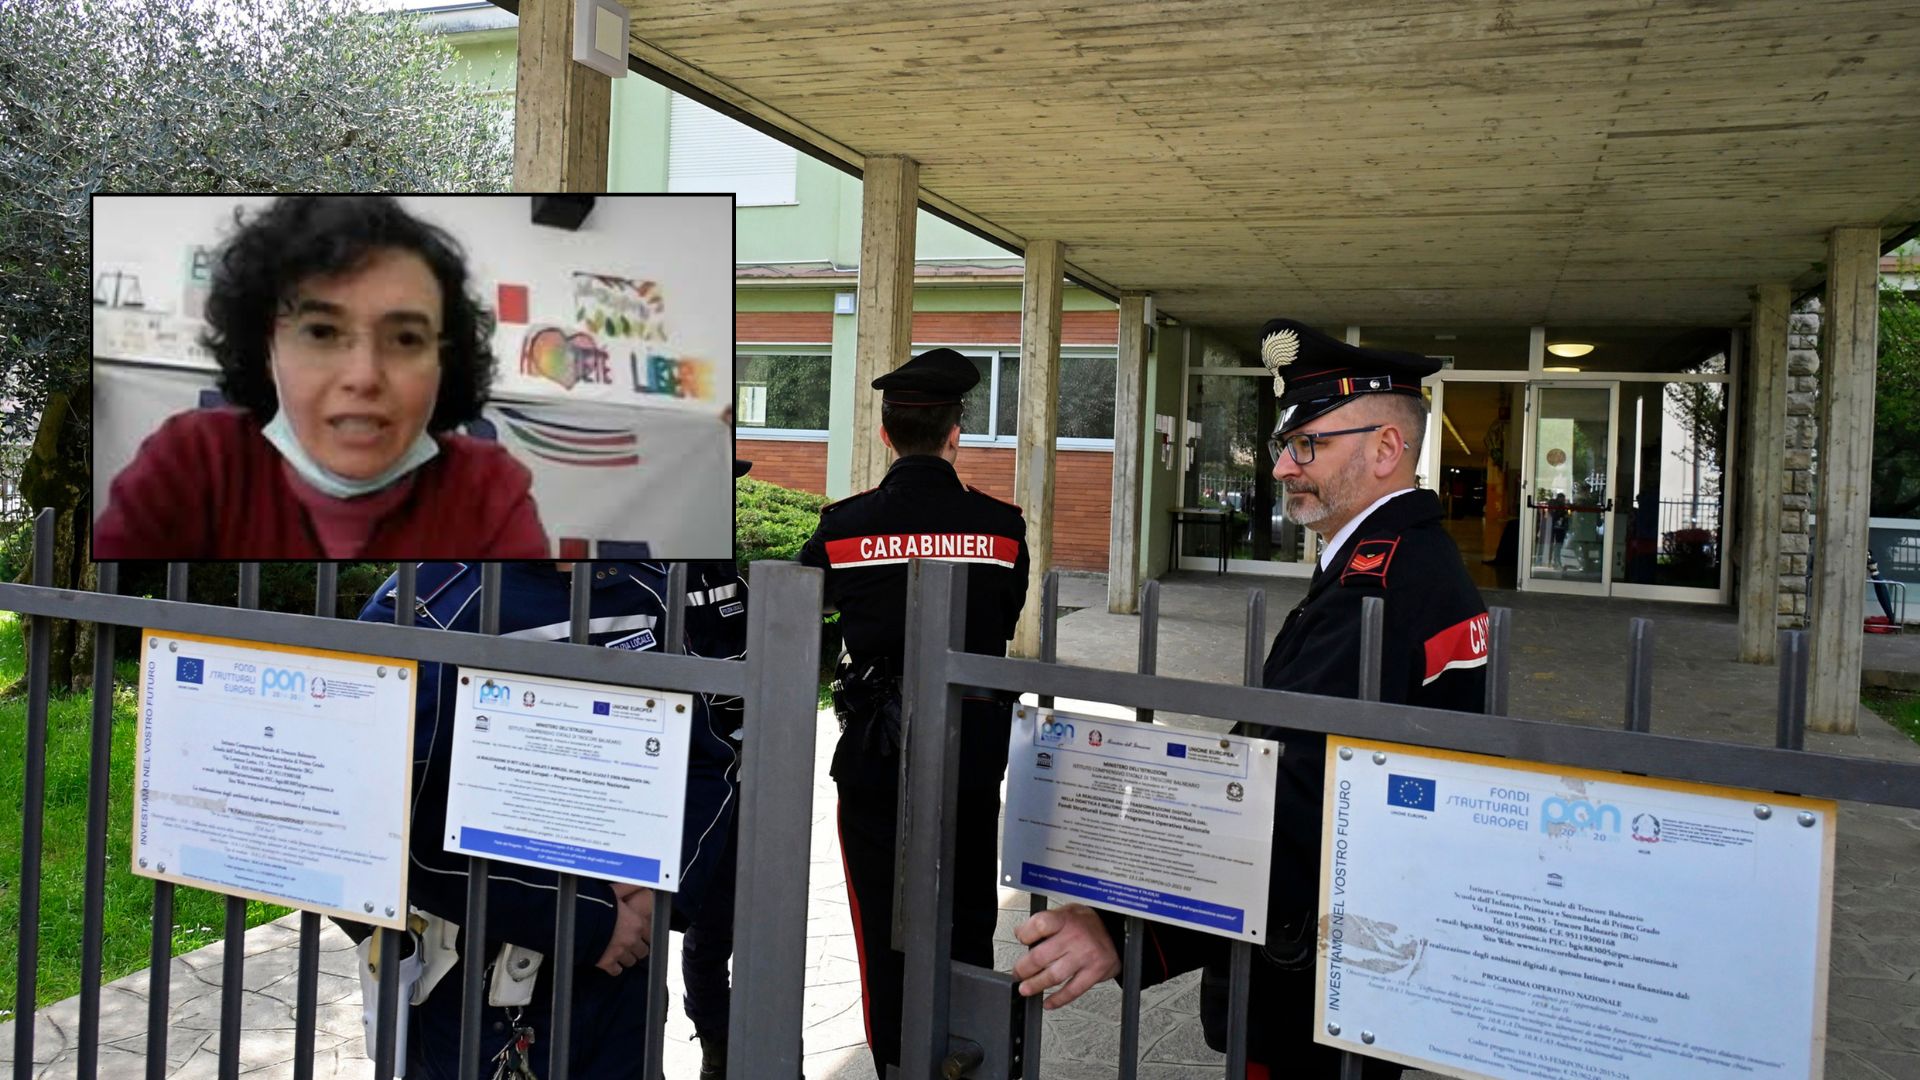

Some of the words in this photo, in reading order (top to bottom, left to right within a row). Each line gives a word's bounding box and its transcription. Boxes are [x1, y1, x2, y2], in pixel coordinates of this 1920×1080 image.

[860, 535, 994, 560] CARABINIERI
[630, 633, 651, 648] LOCALE
[209, 670, 256, 685] STRUTTURALI
[235, 663, 257, 673] FONDI
[224, 684, 256, 695] EUROPEI
[262, 668, 305, 697] pon
[480, 683, 510, 704] pon
[1188, 746, 1208, 754] UNIONE
[1209, 749, 1235, 758] EUROPEA
[1103, 761, 1128, 770] MINISTERO
[1490, 787, 1531, 802] FONDI
[1446, 794, 1530, 817] STRUTTURALI
[1541, 797, 1621, 833] pon
[1073, 805, 1098, 814] Strutturali
[1099, 810, 1119, 818] Europei
[1124, 814, 1155, 825] Programma
[1155, 820, 1182, 829] Operativo
[1183, 825, 1210, 834] Nazionale
[1473, 812, 1529, 831] EUROPEI
[1495, 890, 1541, 905] Comprensivo
[1608, 910, 1645, 923] Balneario
[1524, 904, 1554, 916] Primaria
[1561, 911, 1601, 924] Secondaria
[1583, 925, 1619, 938] Balneario
[1491, 953, 1521, 966] ambienti
[1482, 971, 1530, 988] PROGRAMMA
[1532, 982, 1575, 998] OPERATIVO
[1576, 992, 1622, 1008] NAZIONALE
